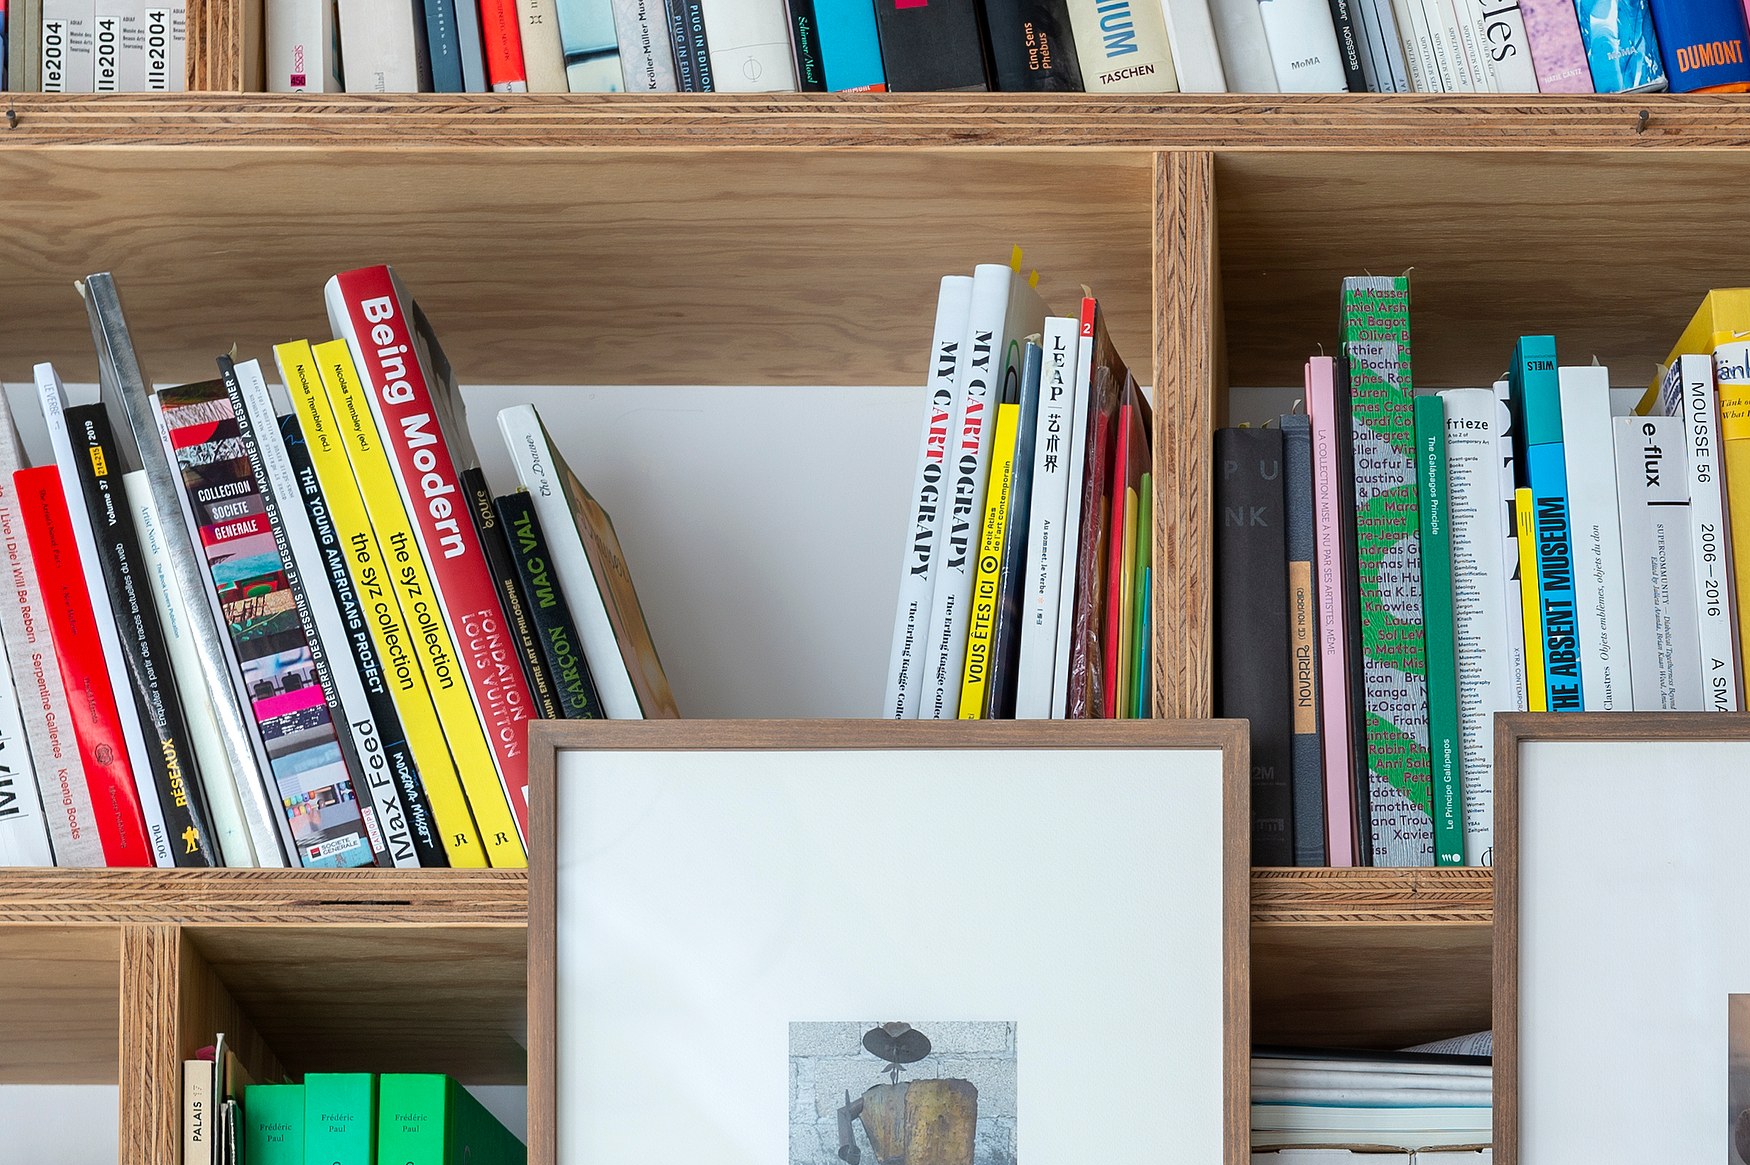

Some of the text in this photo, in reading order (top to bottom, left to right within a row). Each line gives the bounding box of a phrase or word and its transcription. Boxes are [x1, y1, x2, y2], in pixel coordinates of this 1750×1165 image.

[690, 4, 702, 32] PLUG
[695, 34, 704, 47] IN
[1024, 22, 1039, 70] Cinq Sens
[1040, 32, 1051, 69] Phébus
[1343, 26, 1359, 71] SECESSION
[1676, 40, 1743, 73] DUMONT
[290, 74, 307, 86] 450
[1100, 65, 1155, 85] TASCHEN
[1291, 57, 1320, 70] MoMA
[970, 330, 993, 374] MY
[1049, 335, 1066, 401] LEAP
[361, 296, 466, 558] Being Modern
[1043, 414, 1061, 474] 艺术界
[1427, 435, 1436, 451] The
[1447, 419, 1489, 431] frieze
[1692, 382, 1710, 483] MOUSSE 56
[1642, 423, 1663, 488] e-flux
[198, 481, 252, 502] COLLECTION
[212, 502, 249, 520] SOCIETE
[215, 520, 259, 539] GENERALE
[300, 466, 383, 695] THE YOUNG AMERICANS PROJECT
[514, 511, 557, 609] MAC VAL
[1537, 497, 1578, 678] ABSENT MUSEUM
[350, 532, 414, 691] the syz collection
[968, 579, 994, 684] VOUS ÊTES ICI
[165, 739, 189, 807] RÉSEAUX
[351, 719, 414, 860] Max Feed
[58, 768, 80, 840] Koenig Books
[193, 1101, 202, 1142] PALAIS
[321, 1113, 354, 1123] Frédéric
[329, 1125, 346, 1133] Paul
